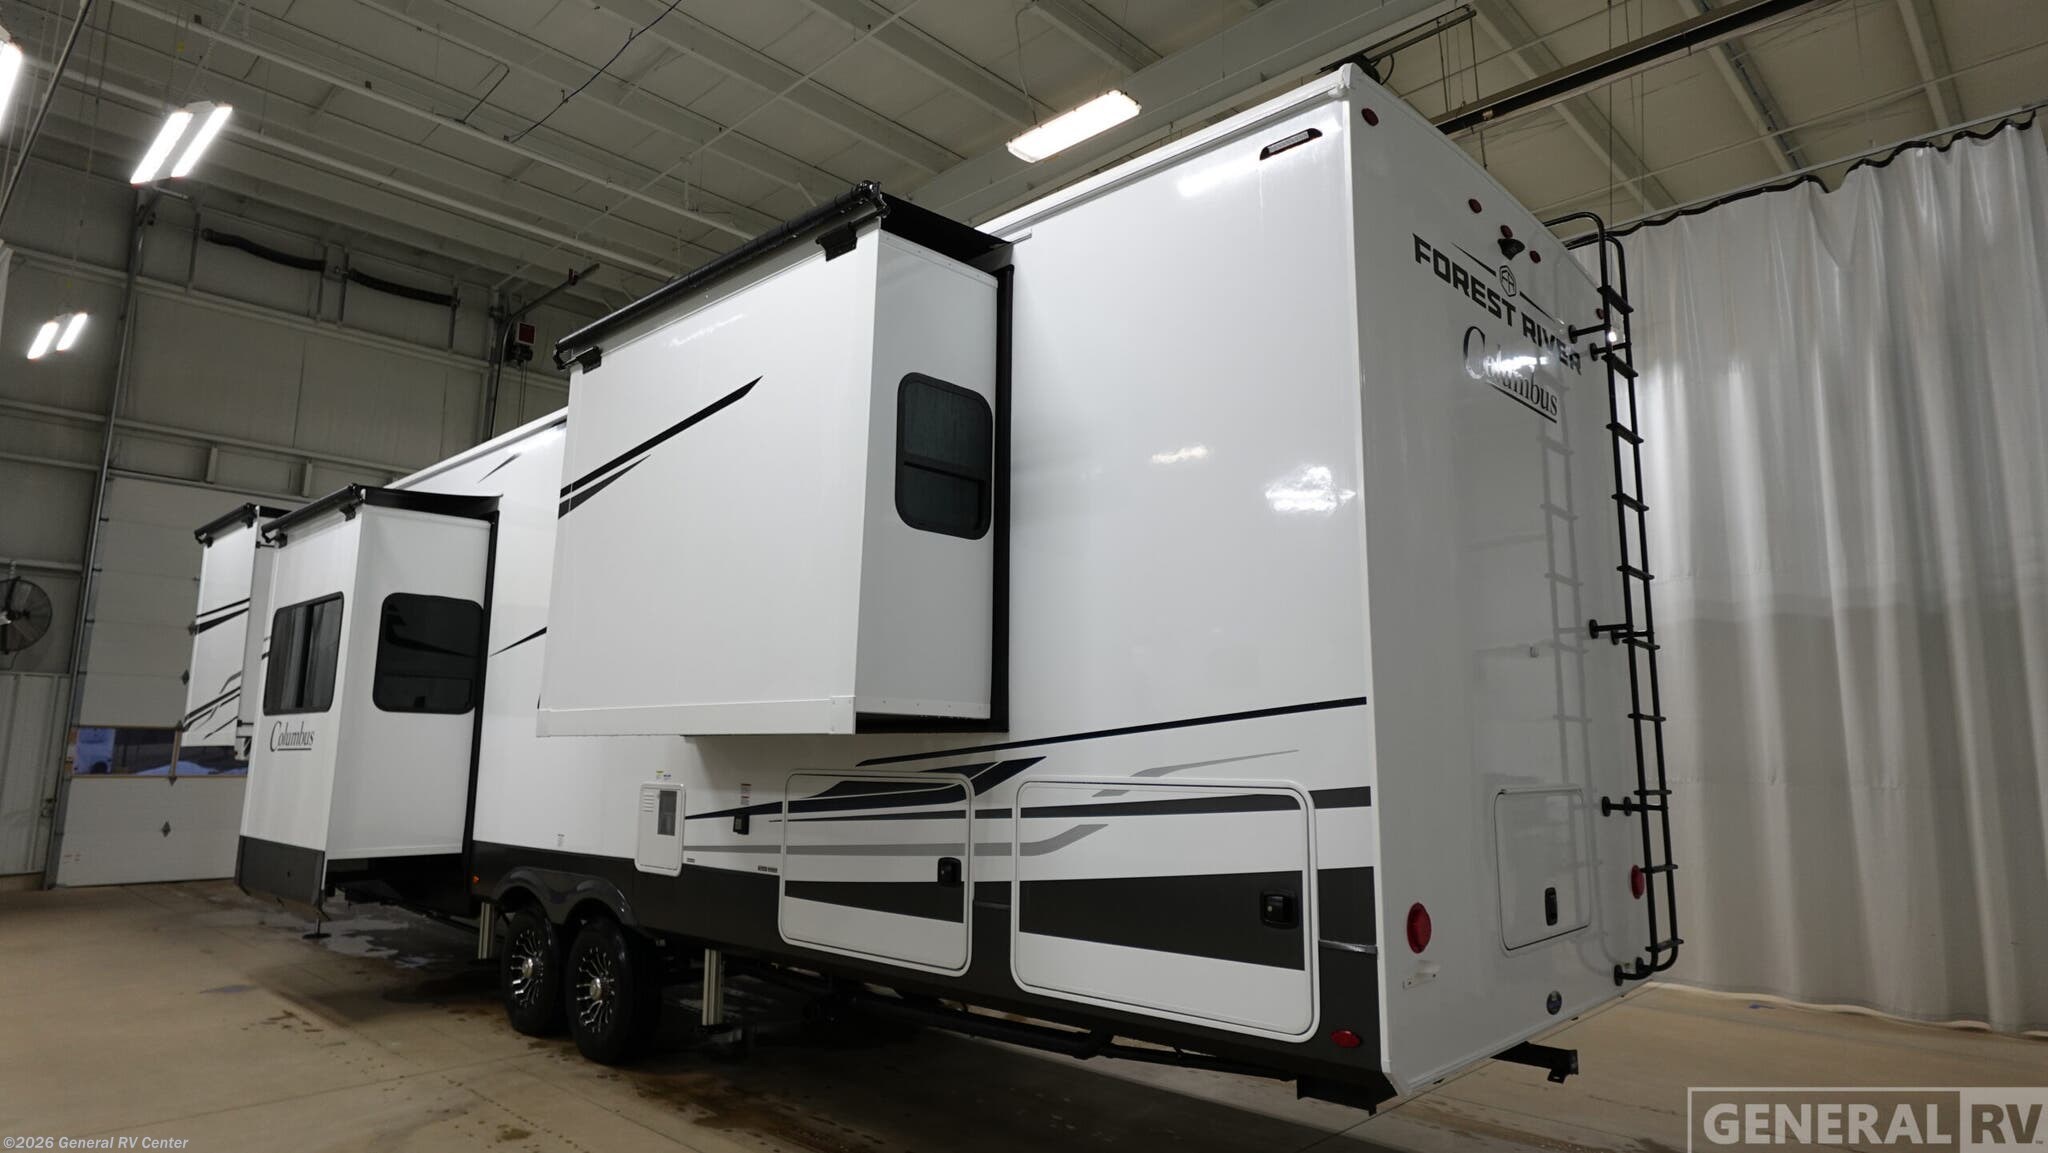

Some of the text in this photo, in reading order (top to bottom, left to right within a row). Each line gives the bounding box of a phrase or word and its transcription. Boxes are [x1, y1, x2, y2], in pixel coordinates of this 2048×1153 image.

[1413, 233, 1582, 376] FOREST RIVER
[270, 720, 315, 752] Columbus
